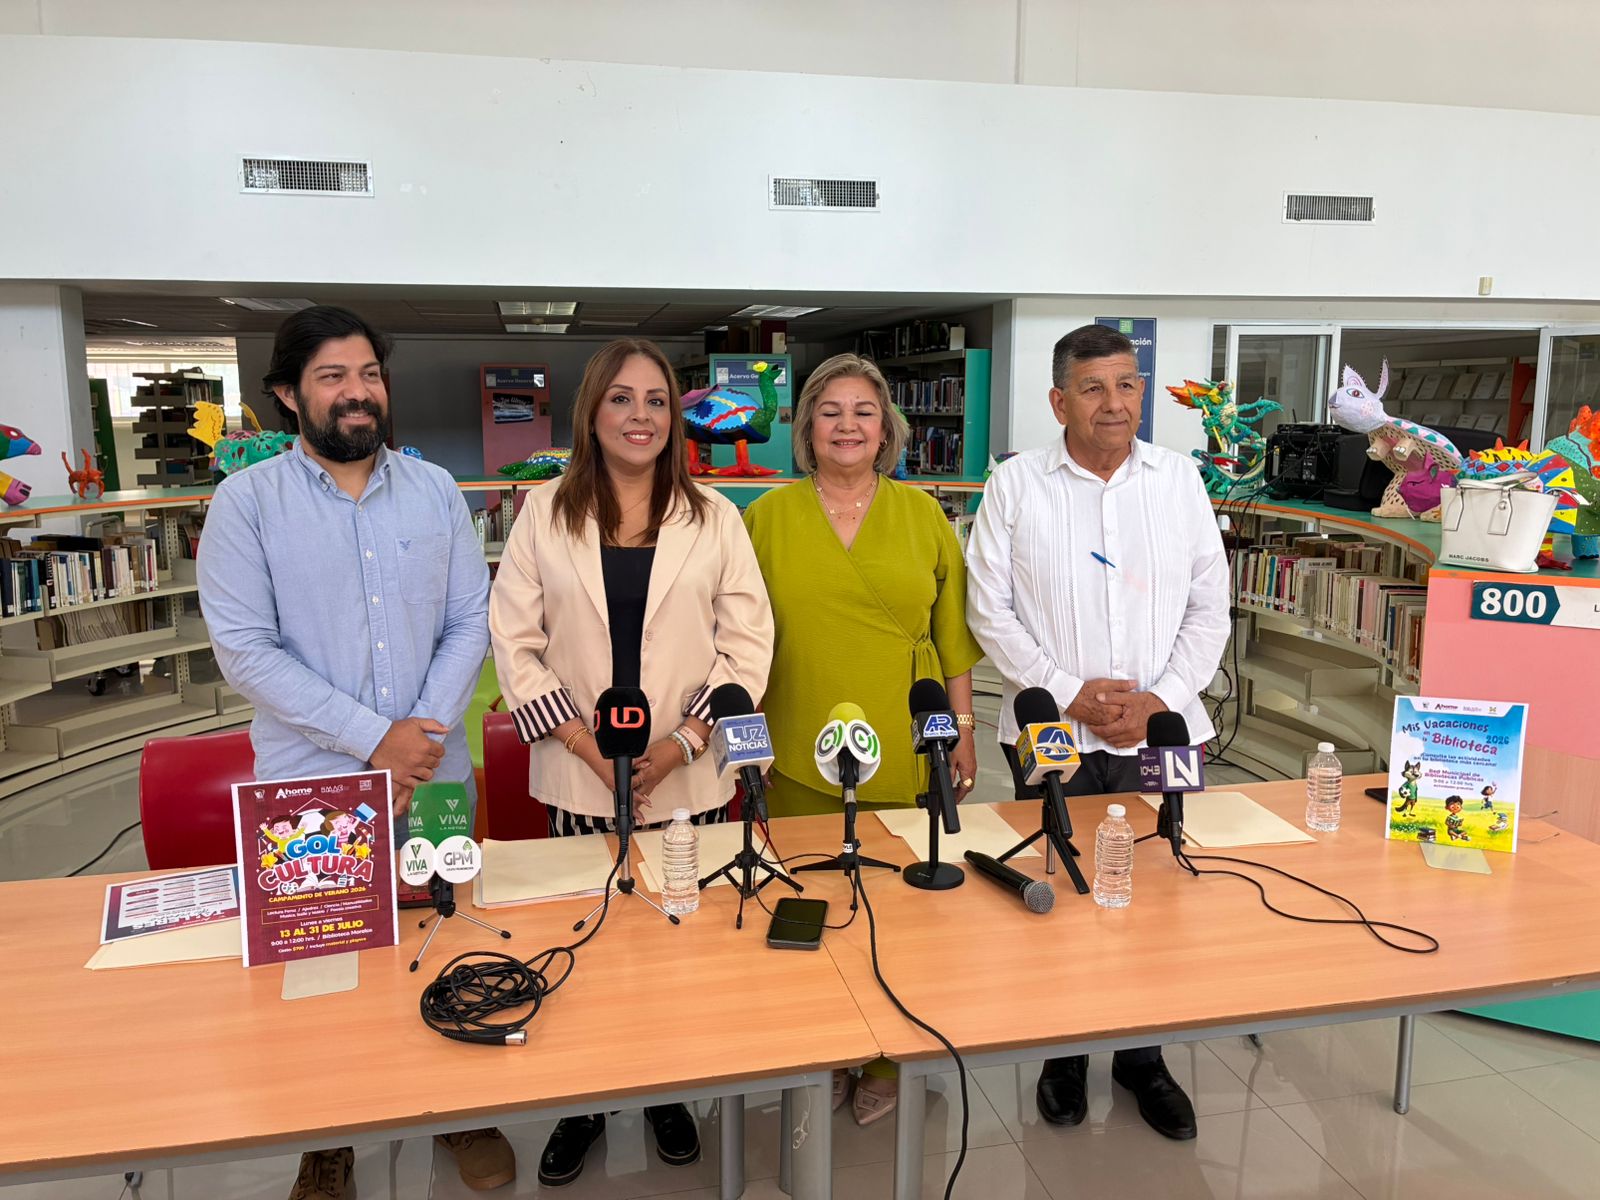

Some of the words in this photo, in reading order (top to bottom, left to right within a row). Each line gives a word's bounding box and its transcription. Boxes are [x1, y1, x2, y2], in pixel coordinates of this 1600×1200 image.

[1480, 588, 1546, 618] 800
[924, 714, 954, 732] AR
[1402, 722, 1420, 734] Mis
[1424, 720, 1488, 732] Vacaciones
[726, 724, 766, 744] LUZ
[1486, 735, 1510, 745] 2026
[729, 741, 768, 752] NOTICIAS
[1432, 733, 1498, 755] Biblioteca
[275, 788, 312, 799] Ahome
[438, 814, 467, 825] VIVA
[286, 835, 341, 859] GOL
[443, 852, 473, 865] GPM
[406, 860, 428, 872] VIVA
[258, 855, 374, 891] CULTURA
[269, 894, 313, 903] CAMPAMENTO
[322, 924, 335, 932] DE
[338, 920, 364, 930] JULIO
[322, 931, 350, 939] Biblioteca
